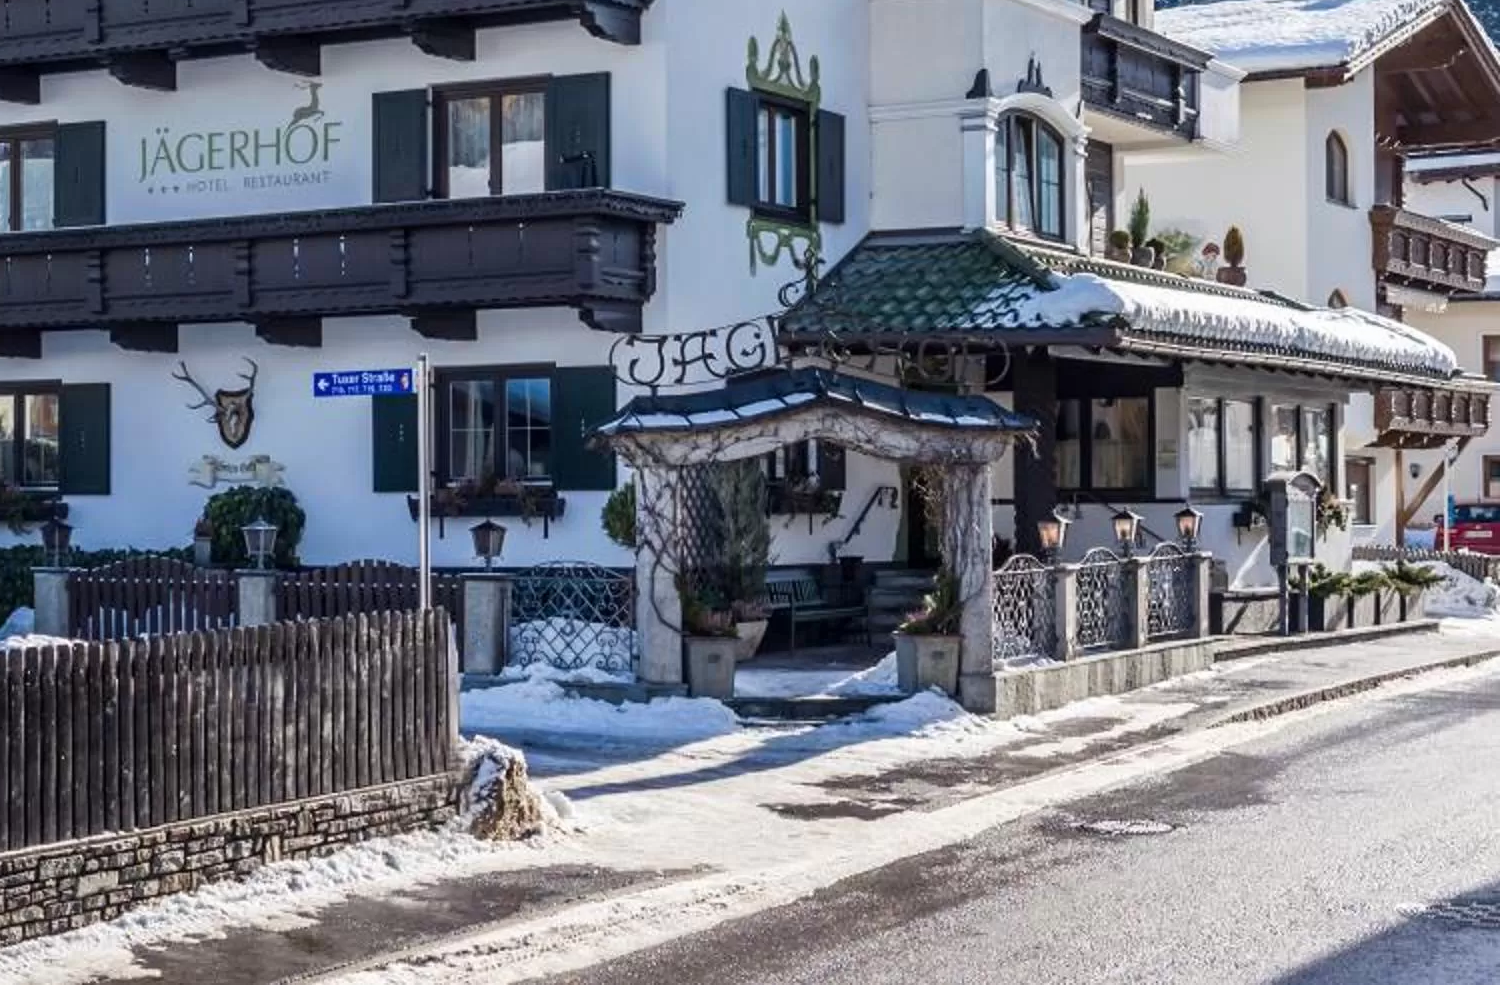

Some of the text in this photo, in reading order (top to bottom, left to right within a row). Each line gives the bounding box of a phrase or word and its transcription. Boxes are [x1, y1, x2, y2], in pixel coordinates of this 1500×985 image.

[138, 121, 342, 183] JÄGERHOF
[186, 170, 332, 193] HOTEL RESTAURANT
[361, 372, 395, 384] Straße
